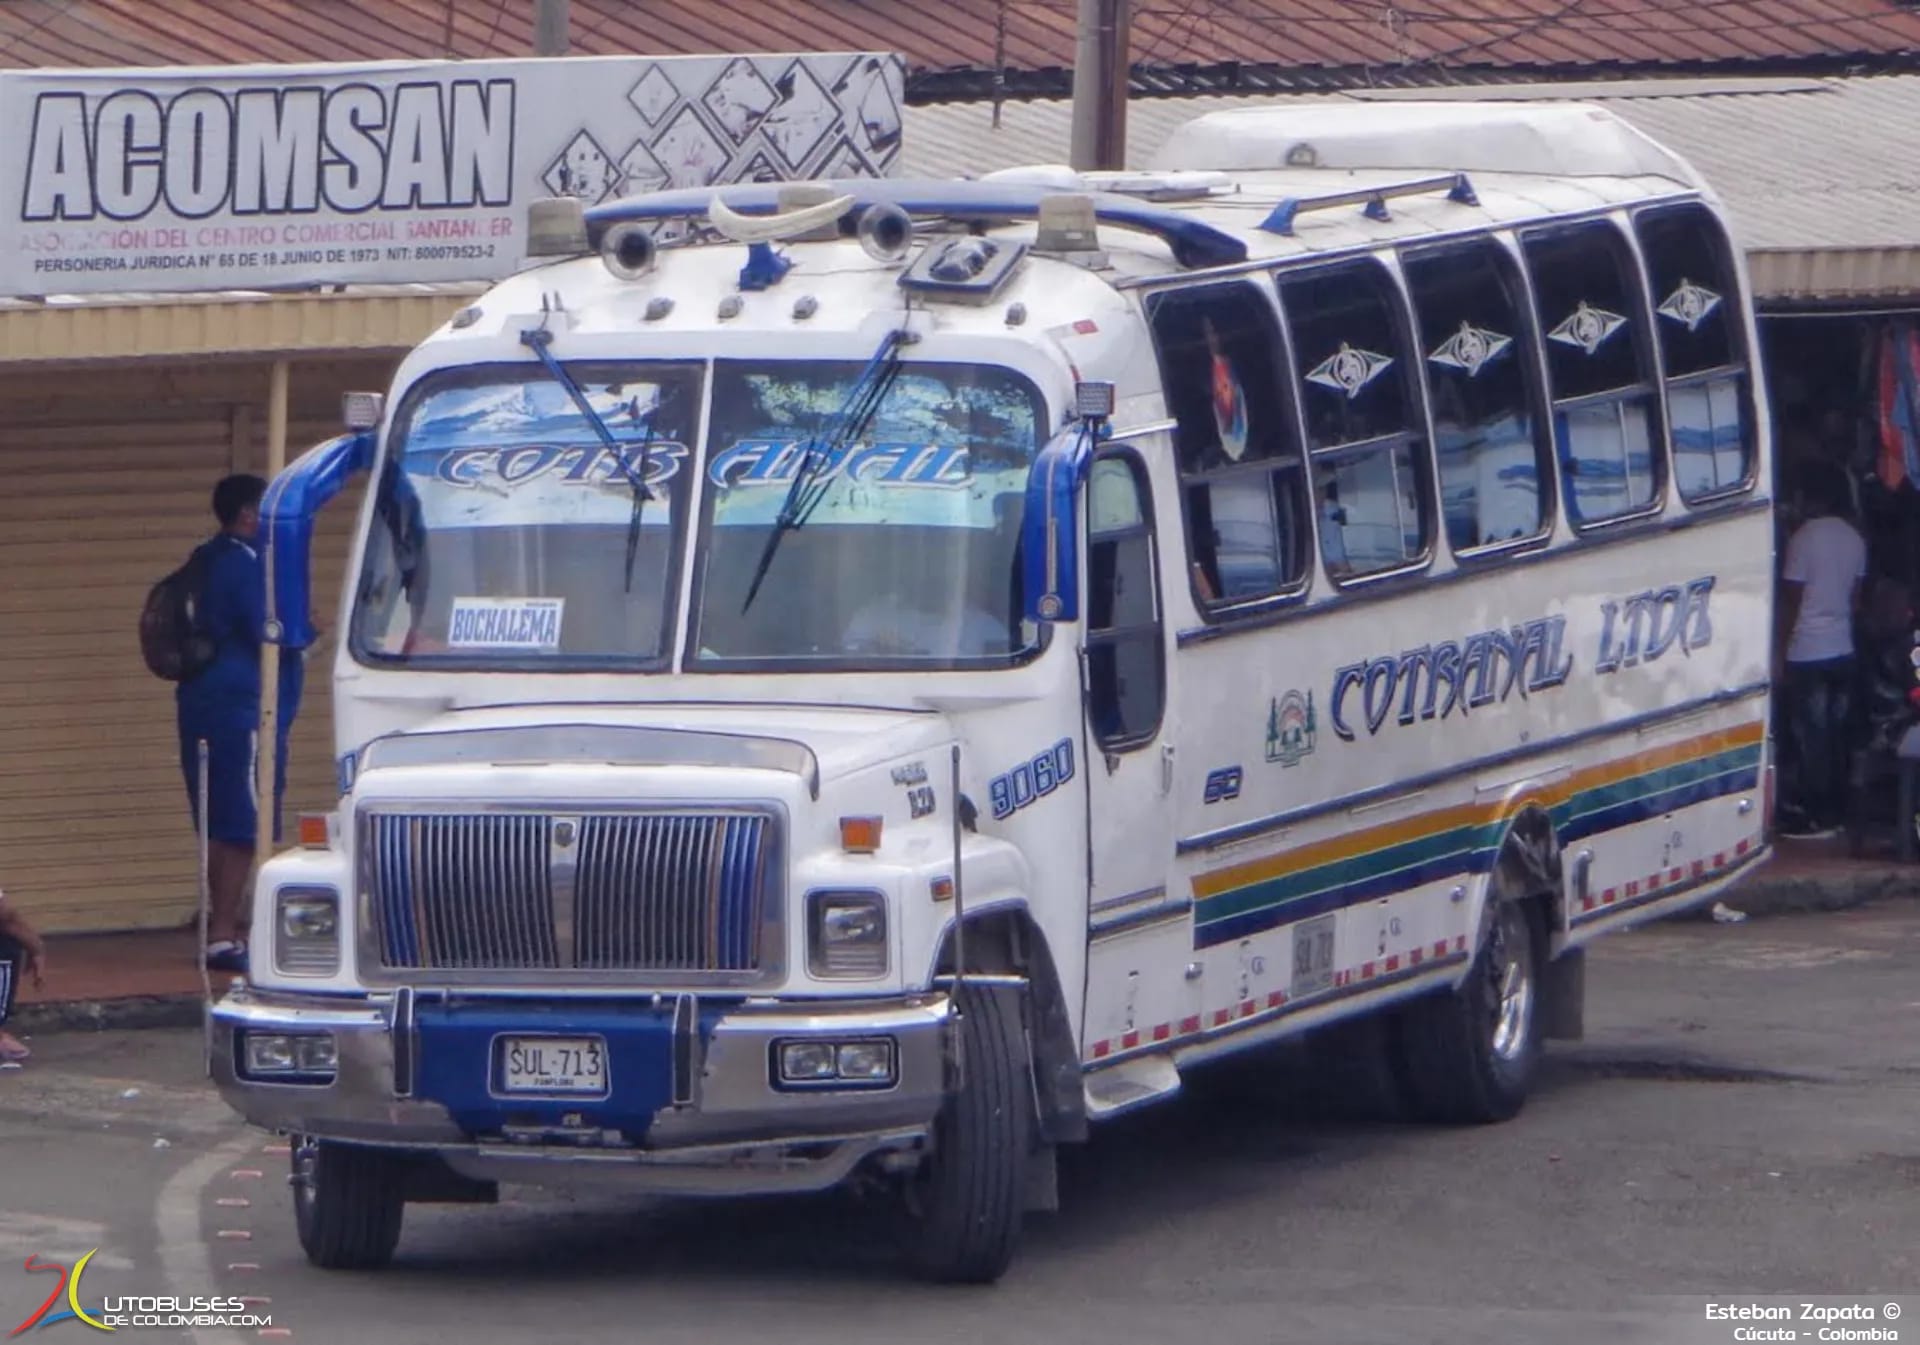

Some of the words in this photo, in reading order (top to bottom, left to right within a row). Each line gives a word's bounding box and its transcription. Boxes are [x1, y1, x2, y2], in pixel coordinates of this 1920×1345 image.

[21, 79, 515, 221] ACOMSAN
[34, 256, 126, 273] PERSONERIA
[130, 254, 197, 271] JURIDICA
[238, 252, 258, 267] DE
[263, 251, 277, 265] 18
[280, 249, 322, 265] JUNIO
[326, 248, 345, 263] DE
[350, 248, 379, 262] 1973
[154, 228, 189, 248] DEL
[196, 226, 276, 247] CENTRO
[282, 221, 395, 244] COMERCIAL
[407, 217, 513, 240] SANTANER
[1330, 614, 1574, 742] COTRANAL
[1595, 575, 1717, 675] LTDA
[989, 737, 1075, 820] 9060
